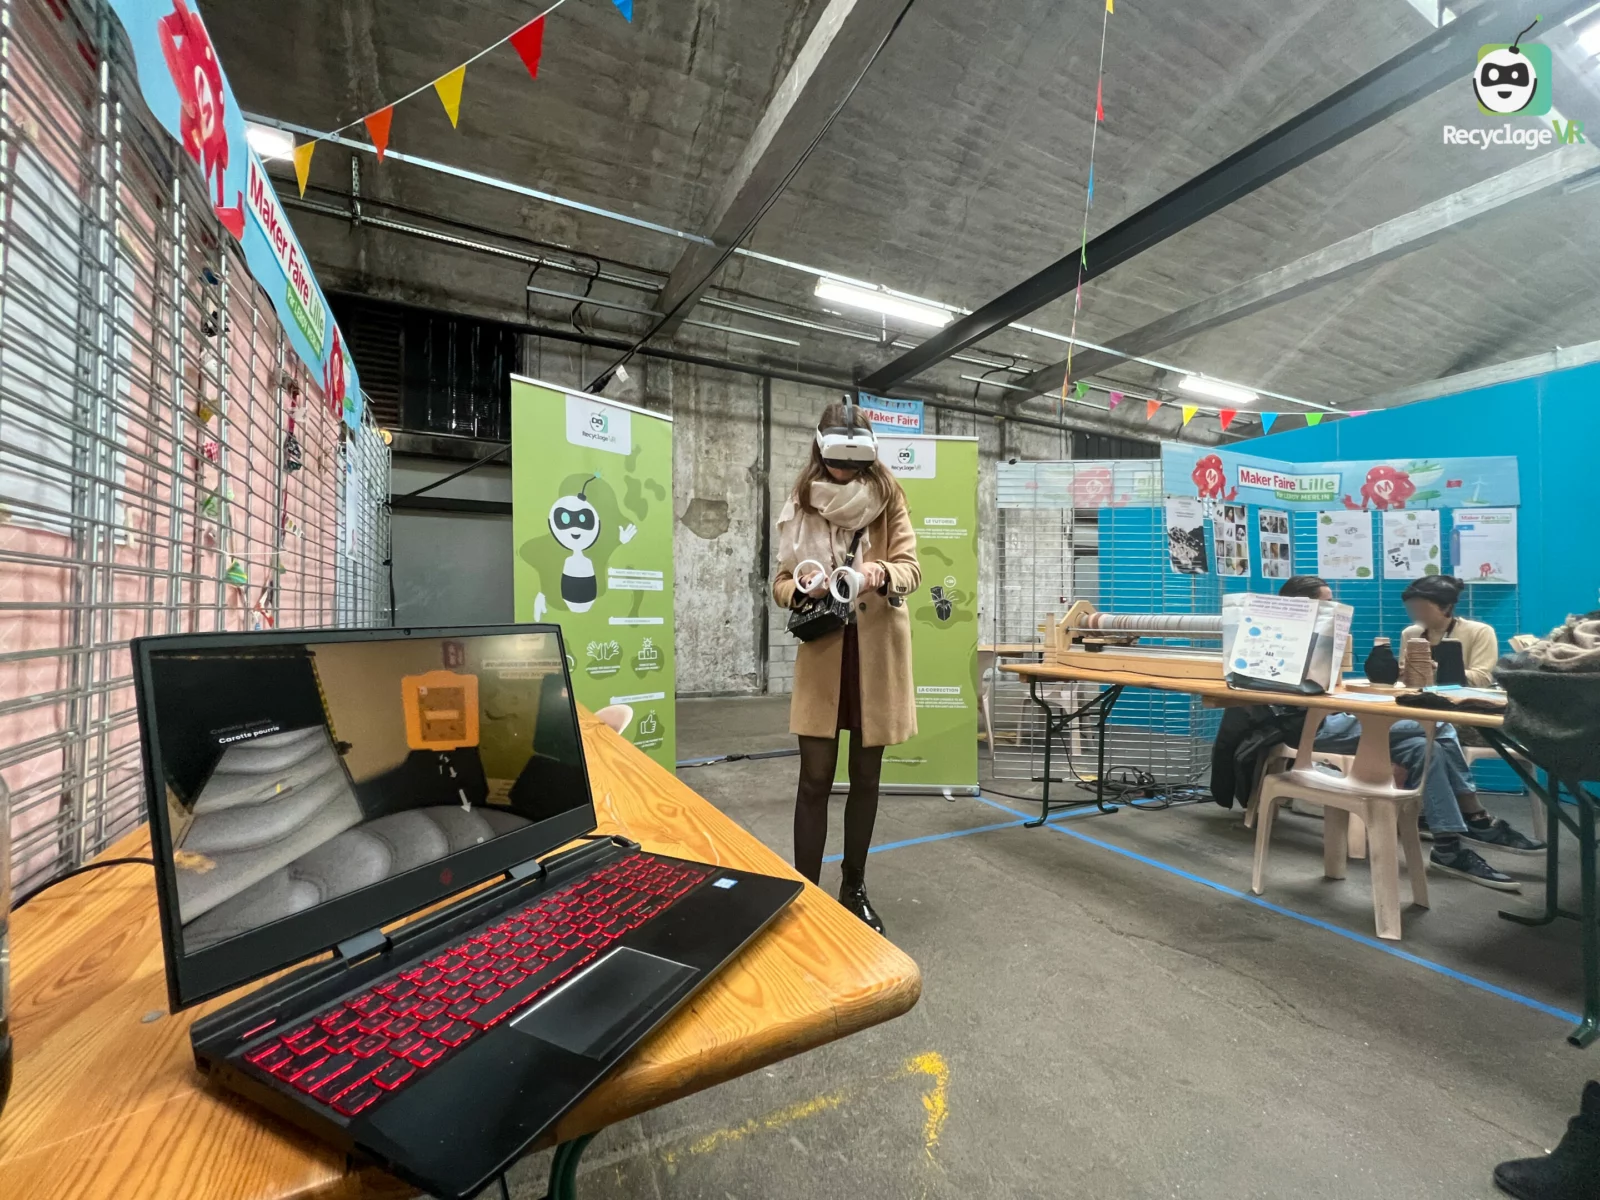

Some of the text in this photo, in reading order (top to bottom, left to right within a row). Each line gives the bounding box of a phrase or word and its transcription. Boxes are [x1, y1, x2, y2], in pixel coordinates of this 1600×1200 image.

[250, 161, 325, 339] Maker Faire Lille
[864, 410, 919, 426] Maker Faire
[1240, 469, 1335, 491] Maker Faire Lille
[218, 725, 280, 744] Carotte pourrie
